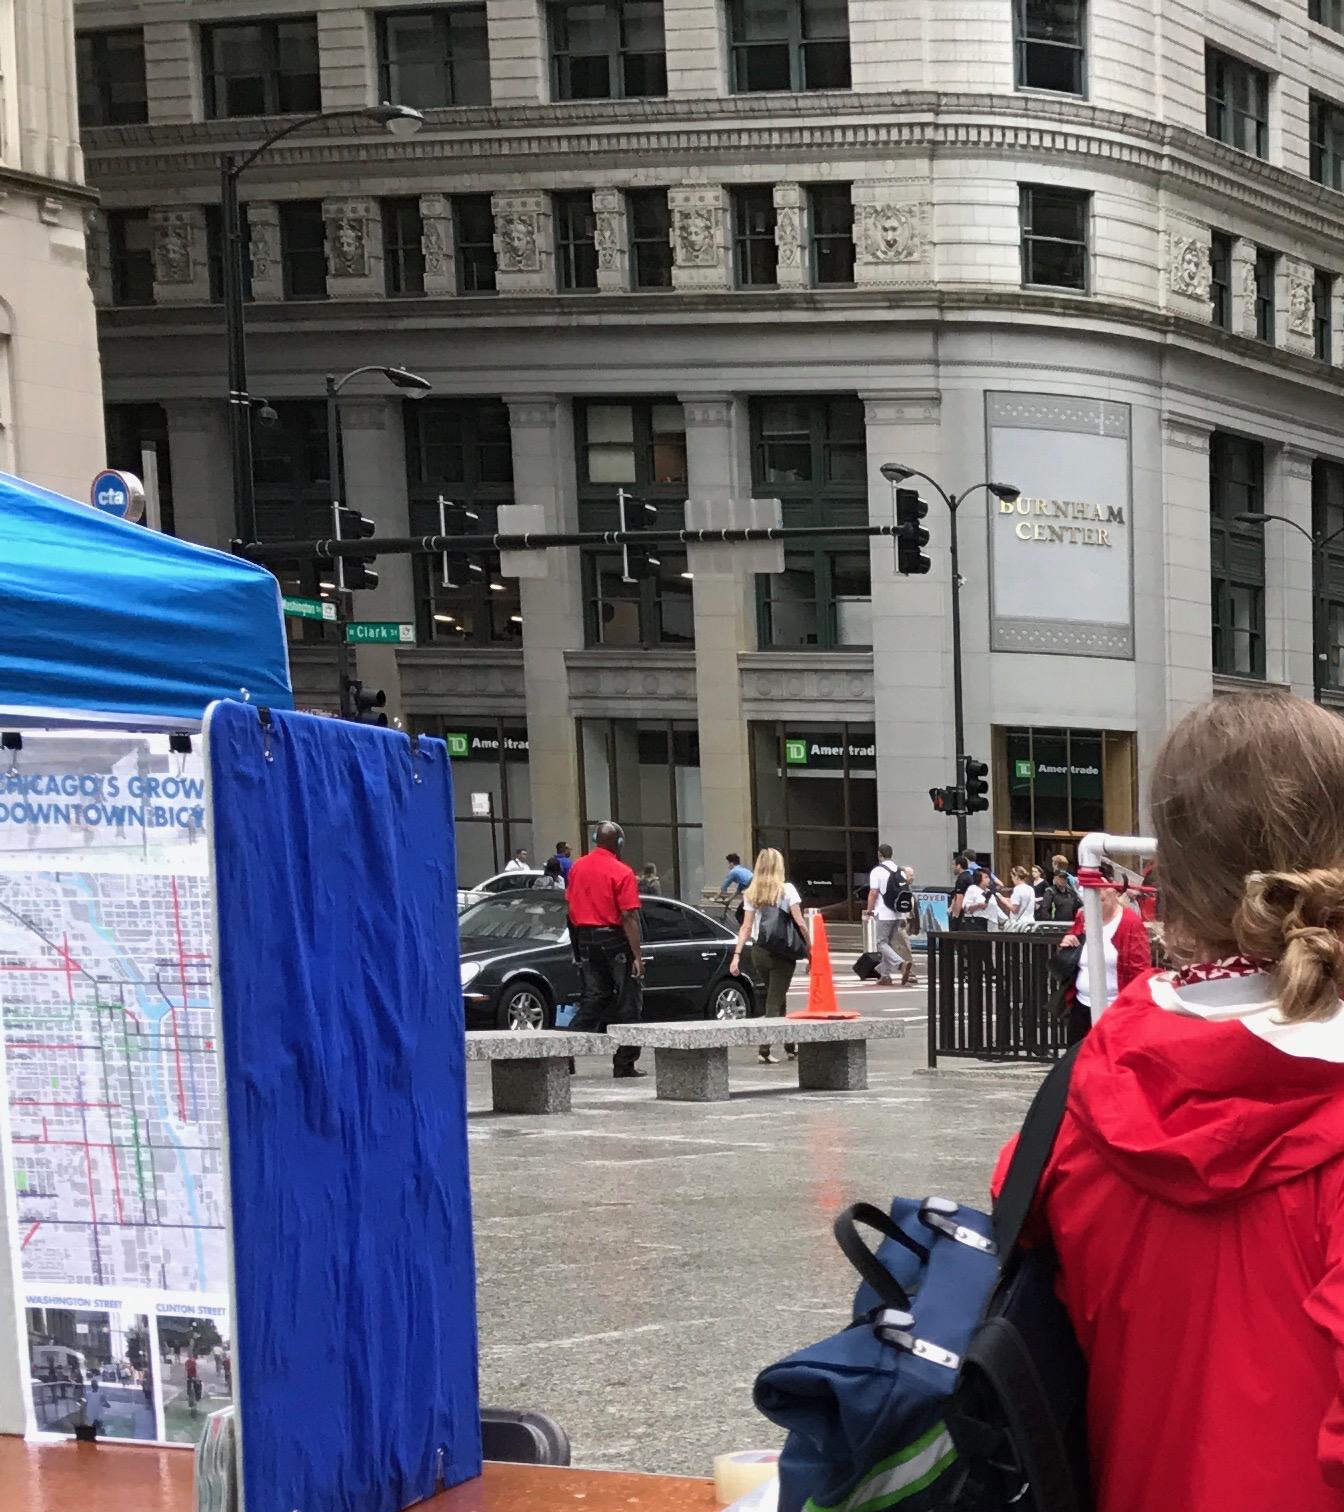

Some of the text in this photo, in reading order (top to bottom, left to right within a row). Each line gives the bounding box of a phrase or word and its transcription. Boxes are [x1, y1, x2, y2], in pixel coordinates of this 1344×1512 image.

[98, 488, 124, 505] cta
[998, 497, 1125, 525] BURNHAM
[1015, 521, 1112, 548] CENTER
[356, 625, 388, 638] Clark
[448, 737, 466, 752] TD
[786, 743, 804, 759] TD
[26, 1295, 122, 1309] WASHINGTON STREET
[156, 1303, 226, 1316] CLINTON STREET
